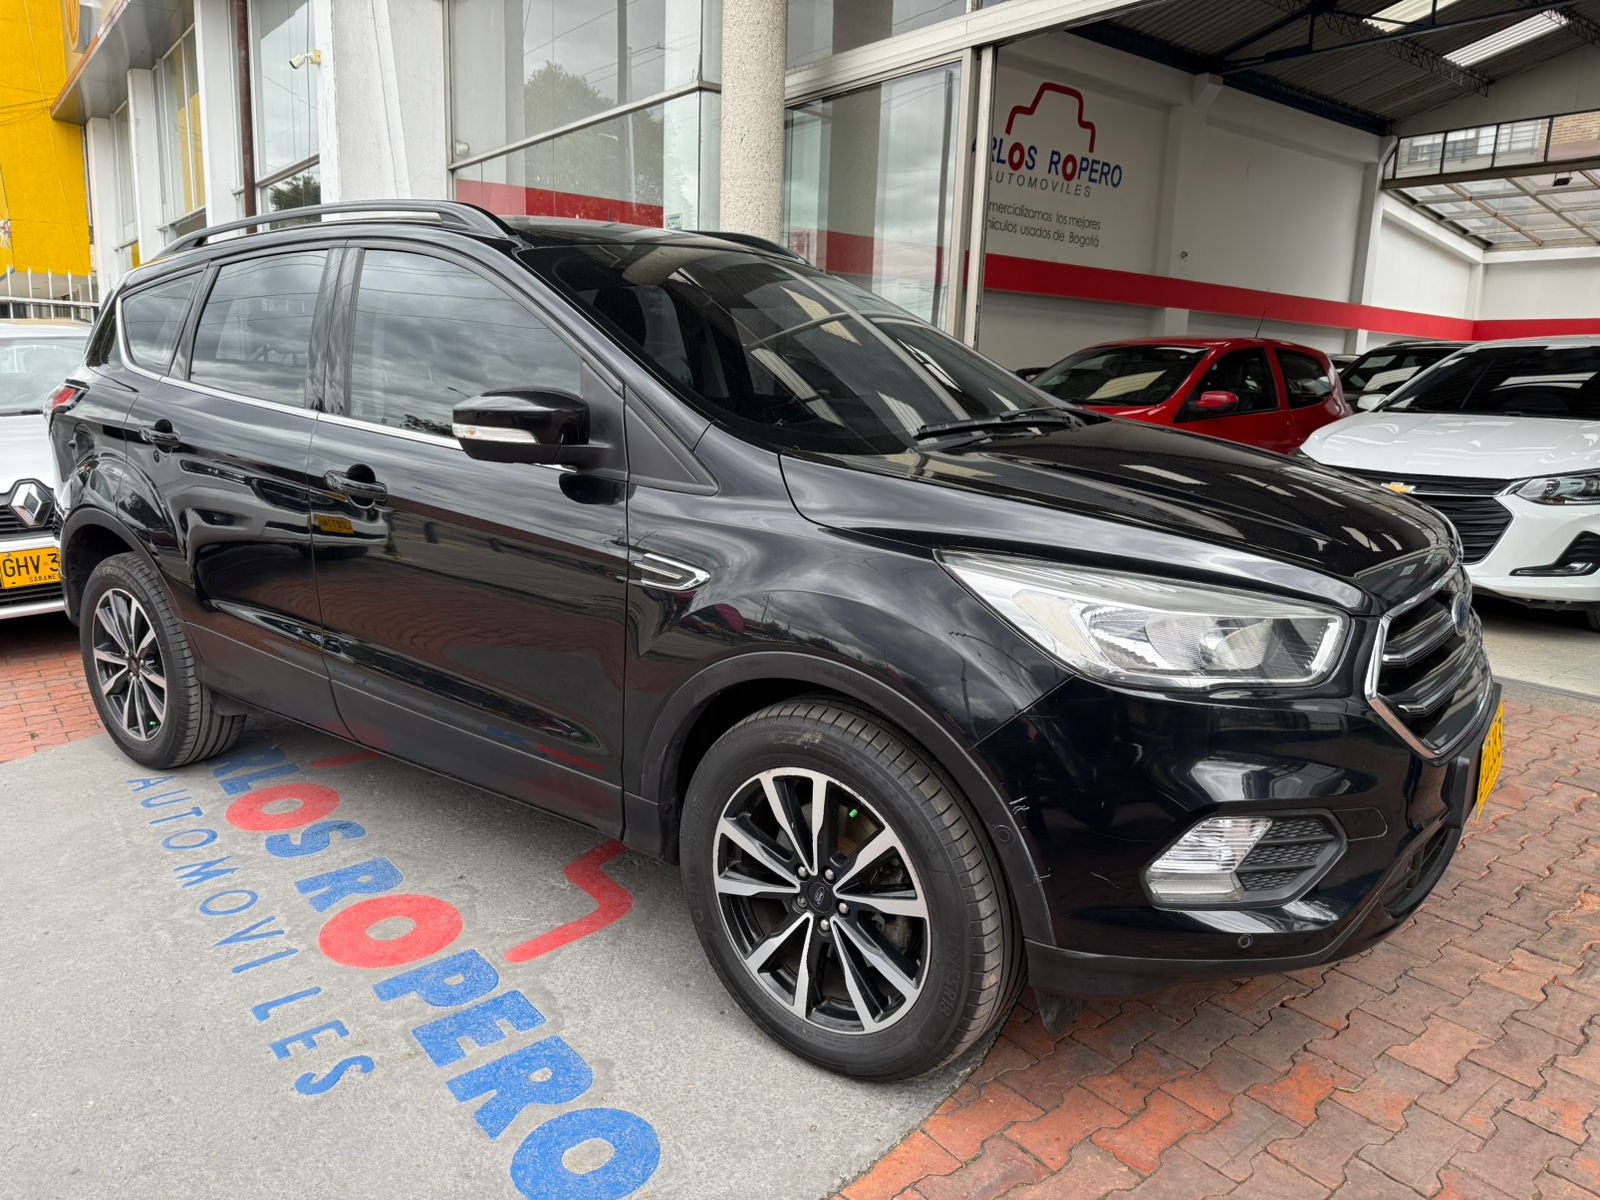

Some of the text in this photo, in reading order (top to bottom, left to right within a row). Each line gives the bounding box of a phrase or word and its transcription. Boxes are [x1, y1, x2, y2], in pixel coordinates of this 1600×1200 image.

[1048, 150, 1122, 188] ROPERO
[990, 170, 1091, 198] UTOMOVILES
[1056, 211, 1067, 225] los
[1069, 215, 1101, 231] mejores
[1019, 225, 1051, 240] usados
[1053, 229, 1065, 242] de
[1068, 231, 1100, 248] Bogotá
[2, 555, 41, 578] GHV
[29, 573, 60, 583] SABANE
[127, 775, 375, 1096] AUTOMOVILES
[294, 856, 661, 1200] ROPERO
